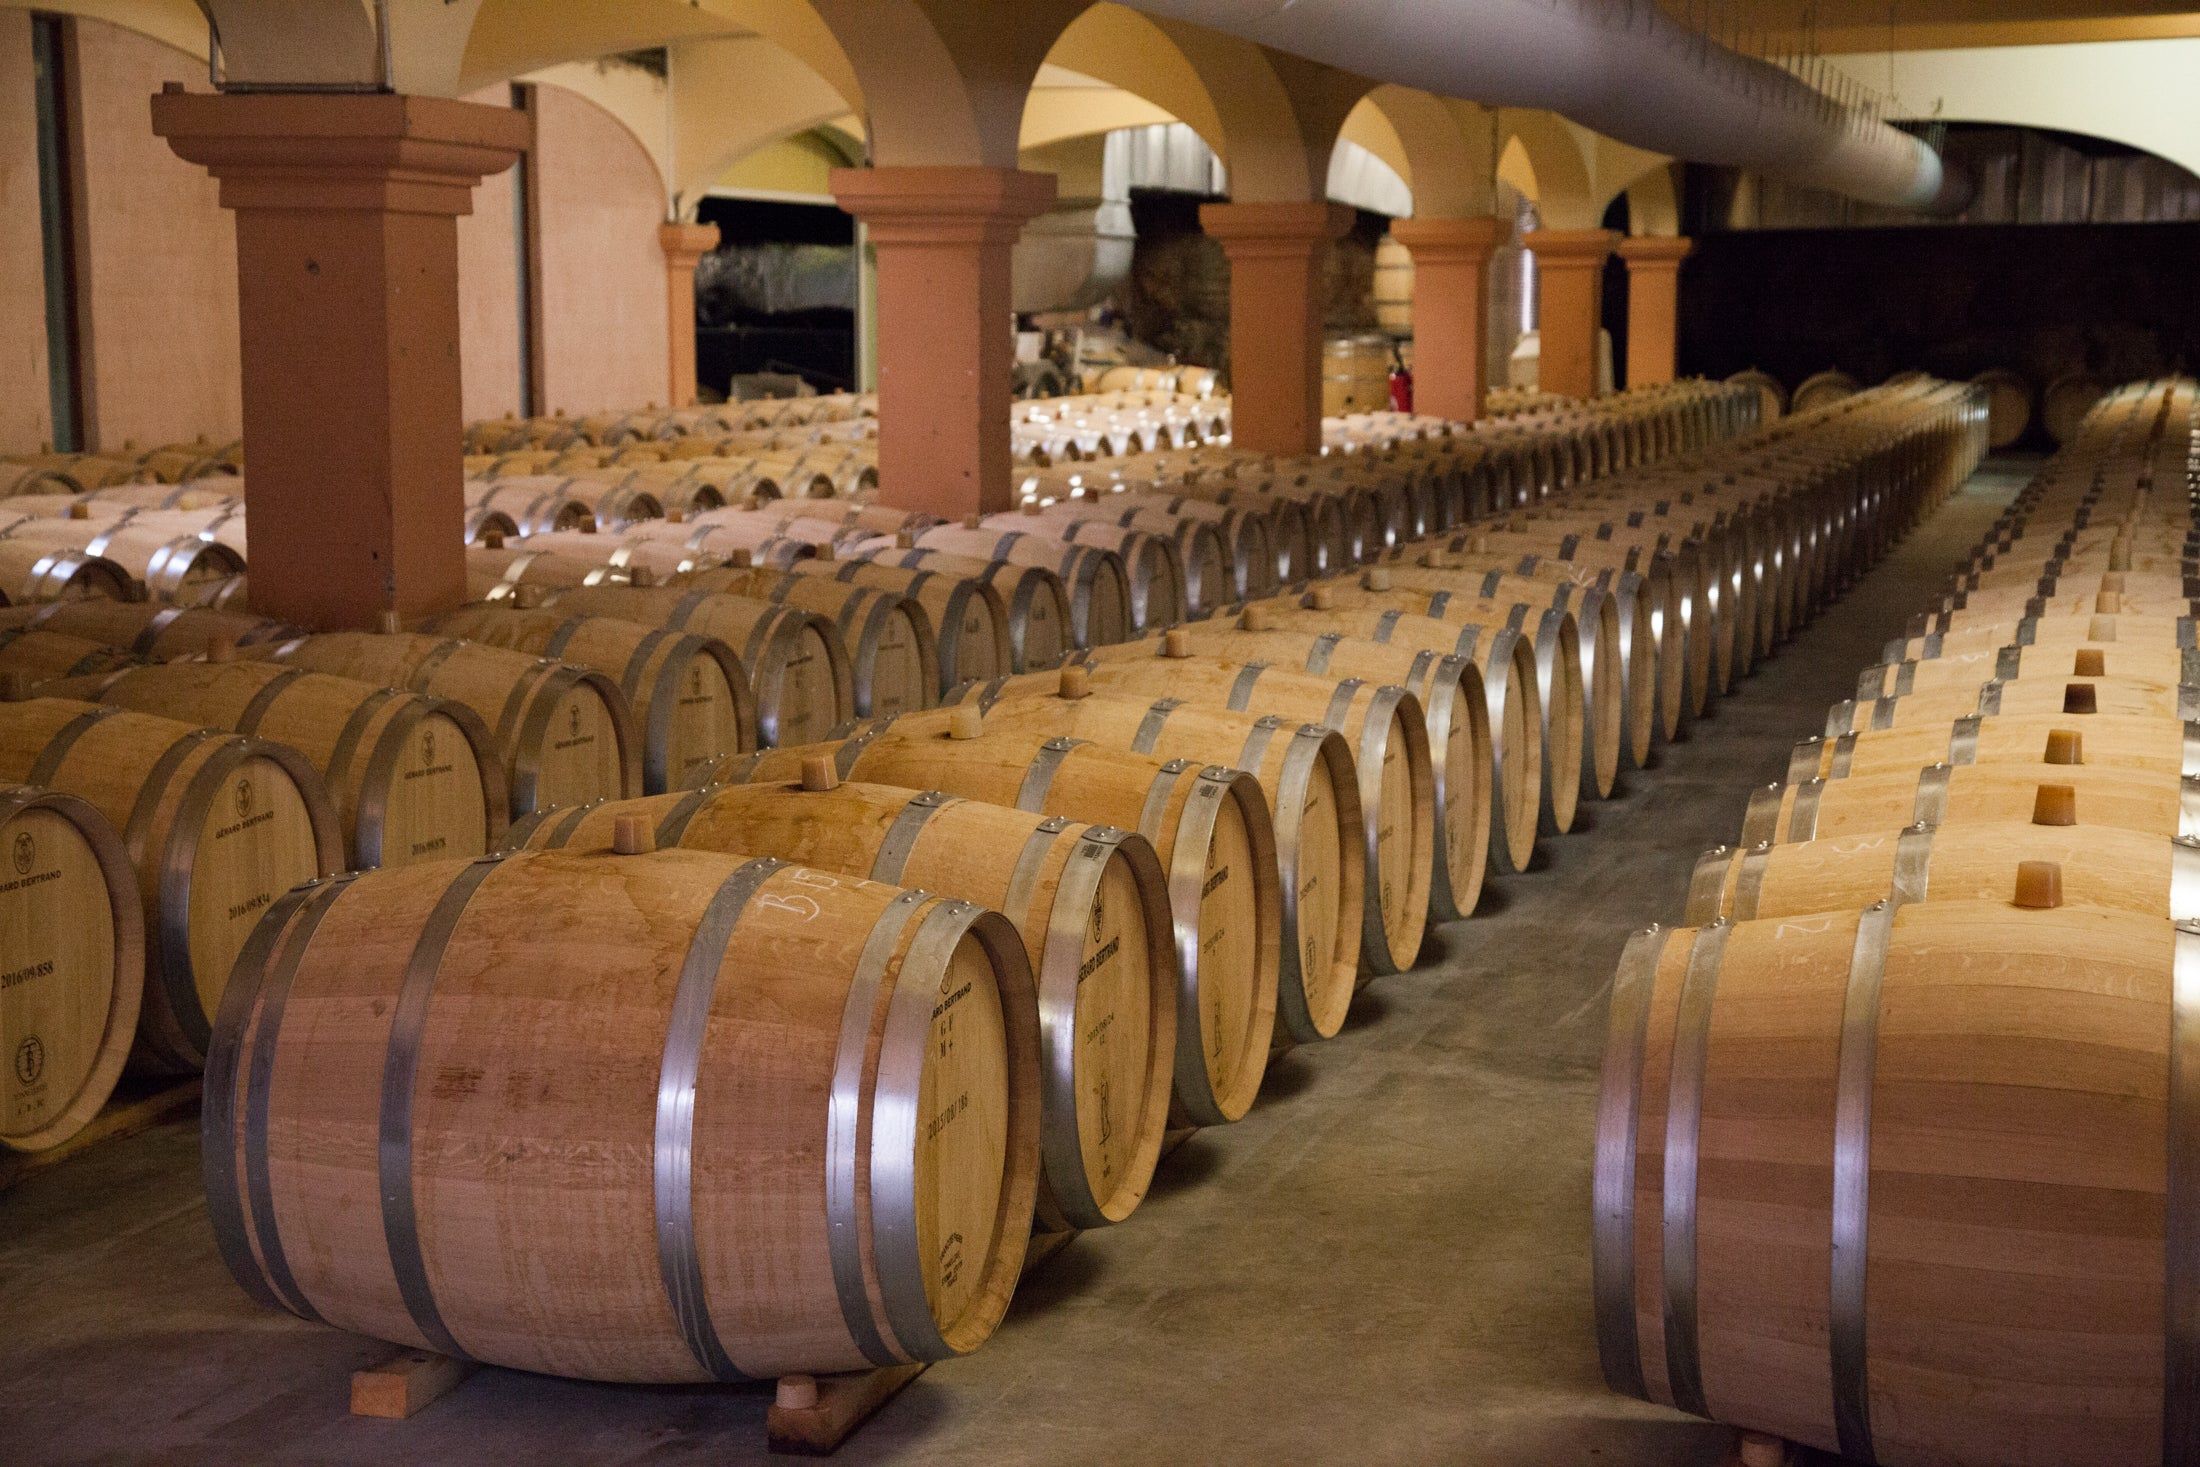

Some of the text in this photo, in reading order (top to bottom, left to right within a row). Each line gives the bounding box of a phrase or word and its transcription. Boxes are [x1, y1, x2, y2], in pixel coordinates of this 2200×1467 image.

[242, 810, 274, 829] BERTRAND
[21, 870, 62, 888] BERTRAND
[944, 982, 972, 1011] BERTRAND
